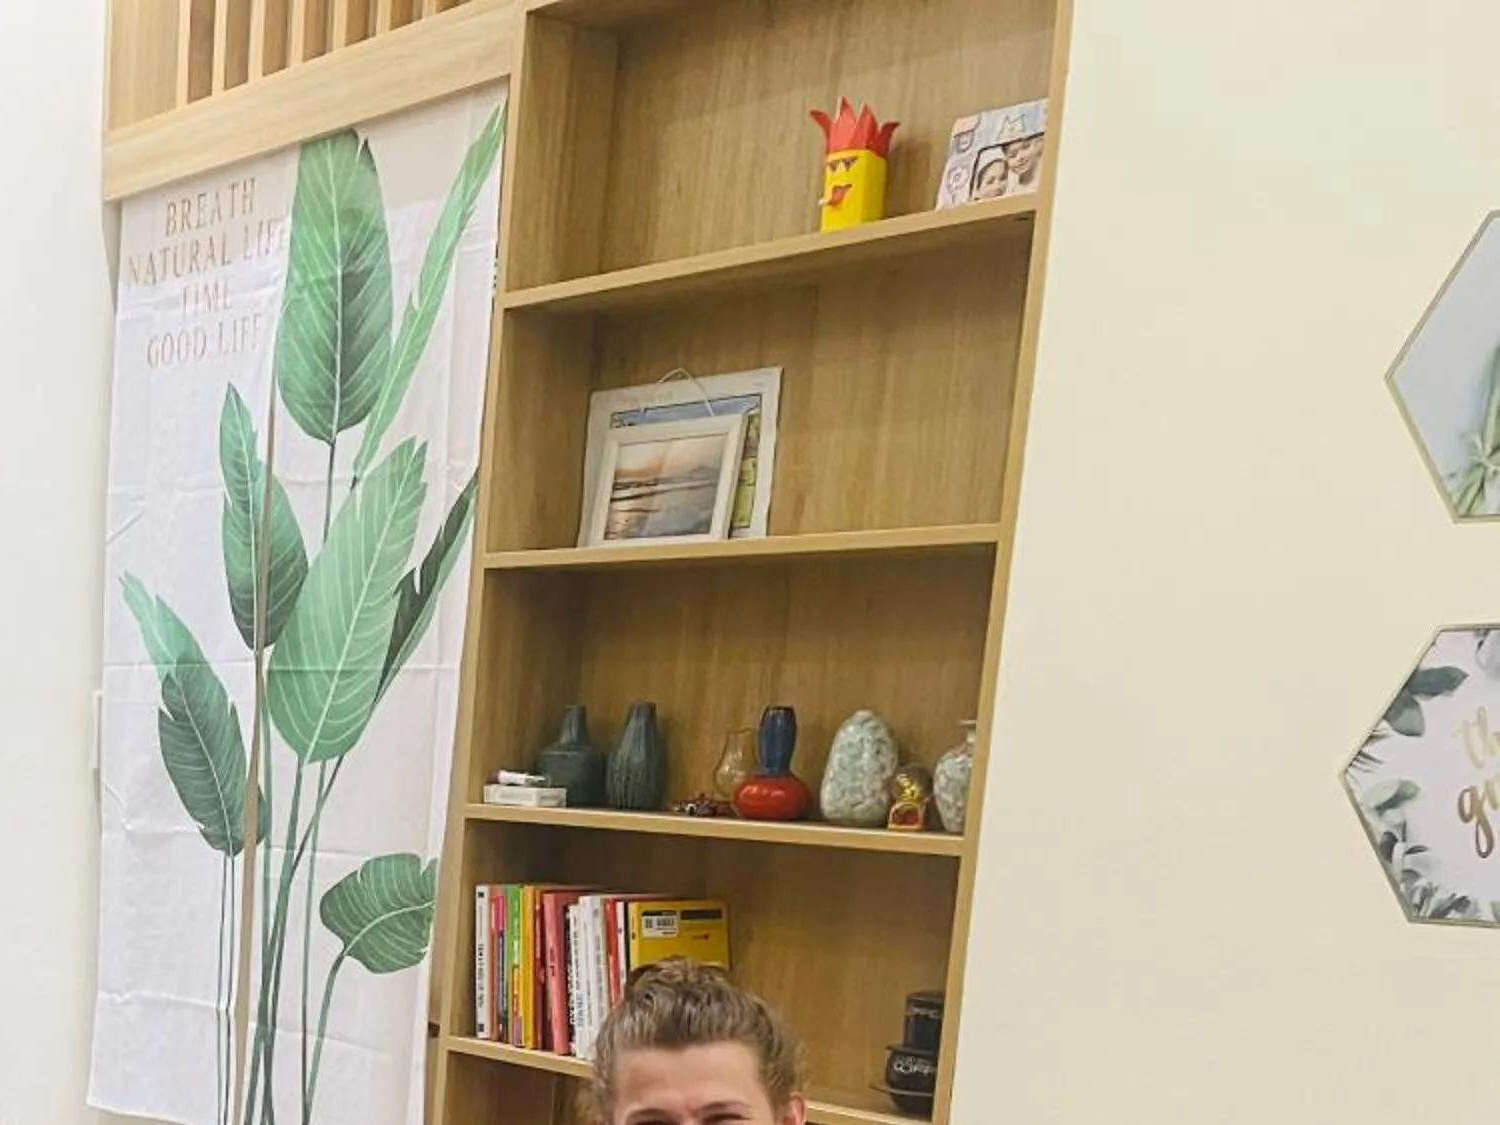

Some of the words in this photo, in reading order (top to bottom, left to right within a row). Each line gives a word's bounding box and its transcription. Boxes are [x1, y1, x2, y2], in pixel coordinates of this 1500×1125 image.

[165, 177, 257, 237] BREATH
[128, 231, 232, 289] NATURAL
[147, 327, 207, 369] GOOD
